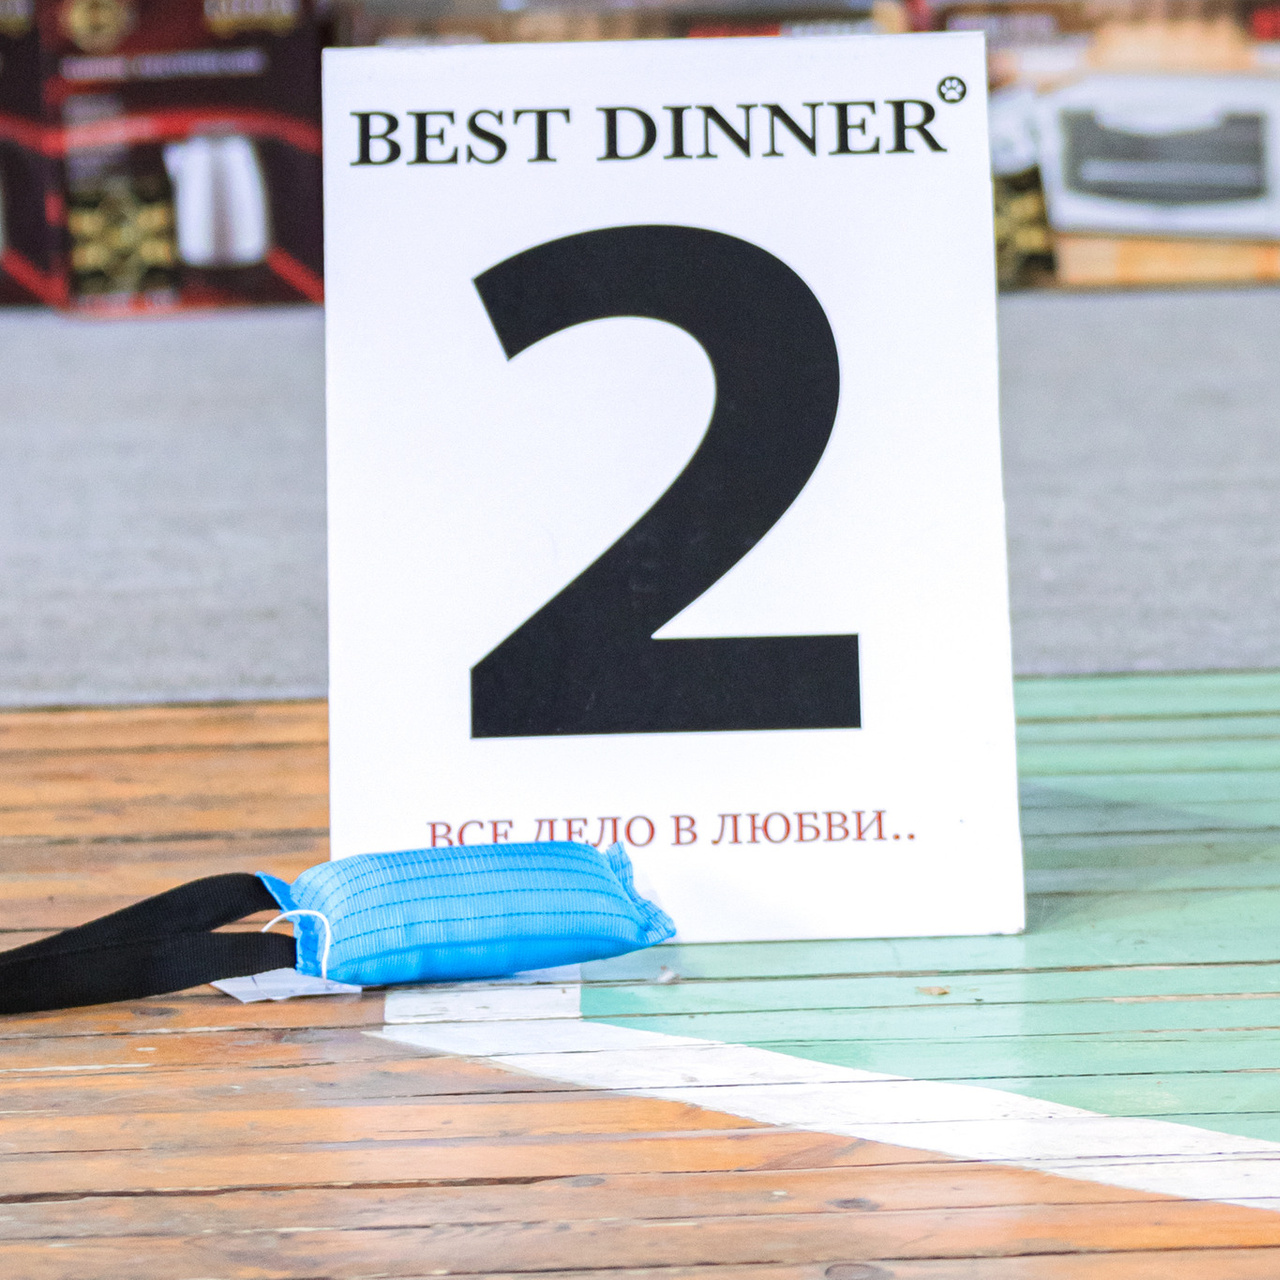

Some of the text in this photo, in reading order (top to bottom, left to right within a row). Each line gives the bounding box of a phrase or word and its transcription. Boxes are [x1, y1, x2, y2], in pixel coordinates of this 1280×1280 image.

[349, 99, 948, 167] BEST DINNER
[470, 223, 863, 740] 2
[670, 814, 698, 846] В
